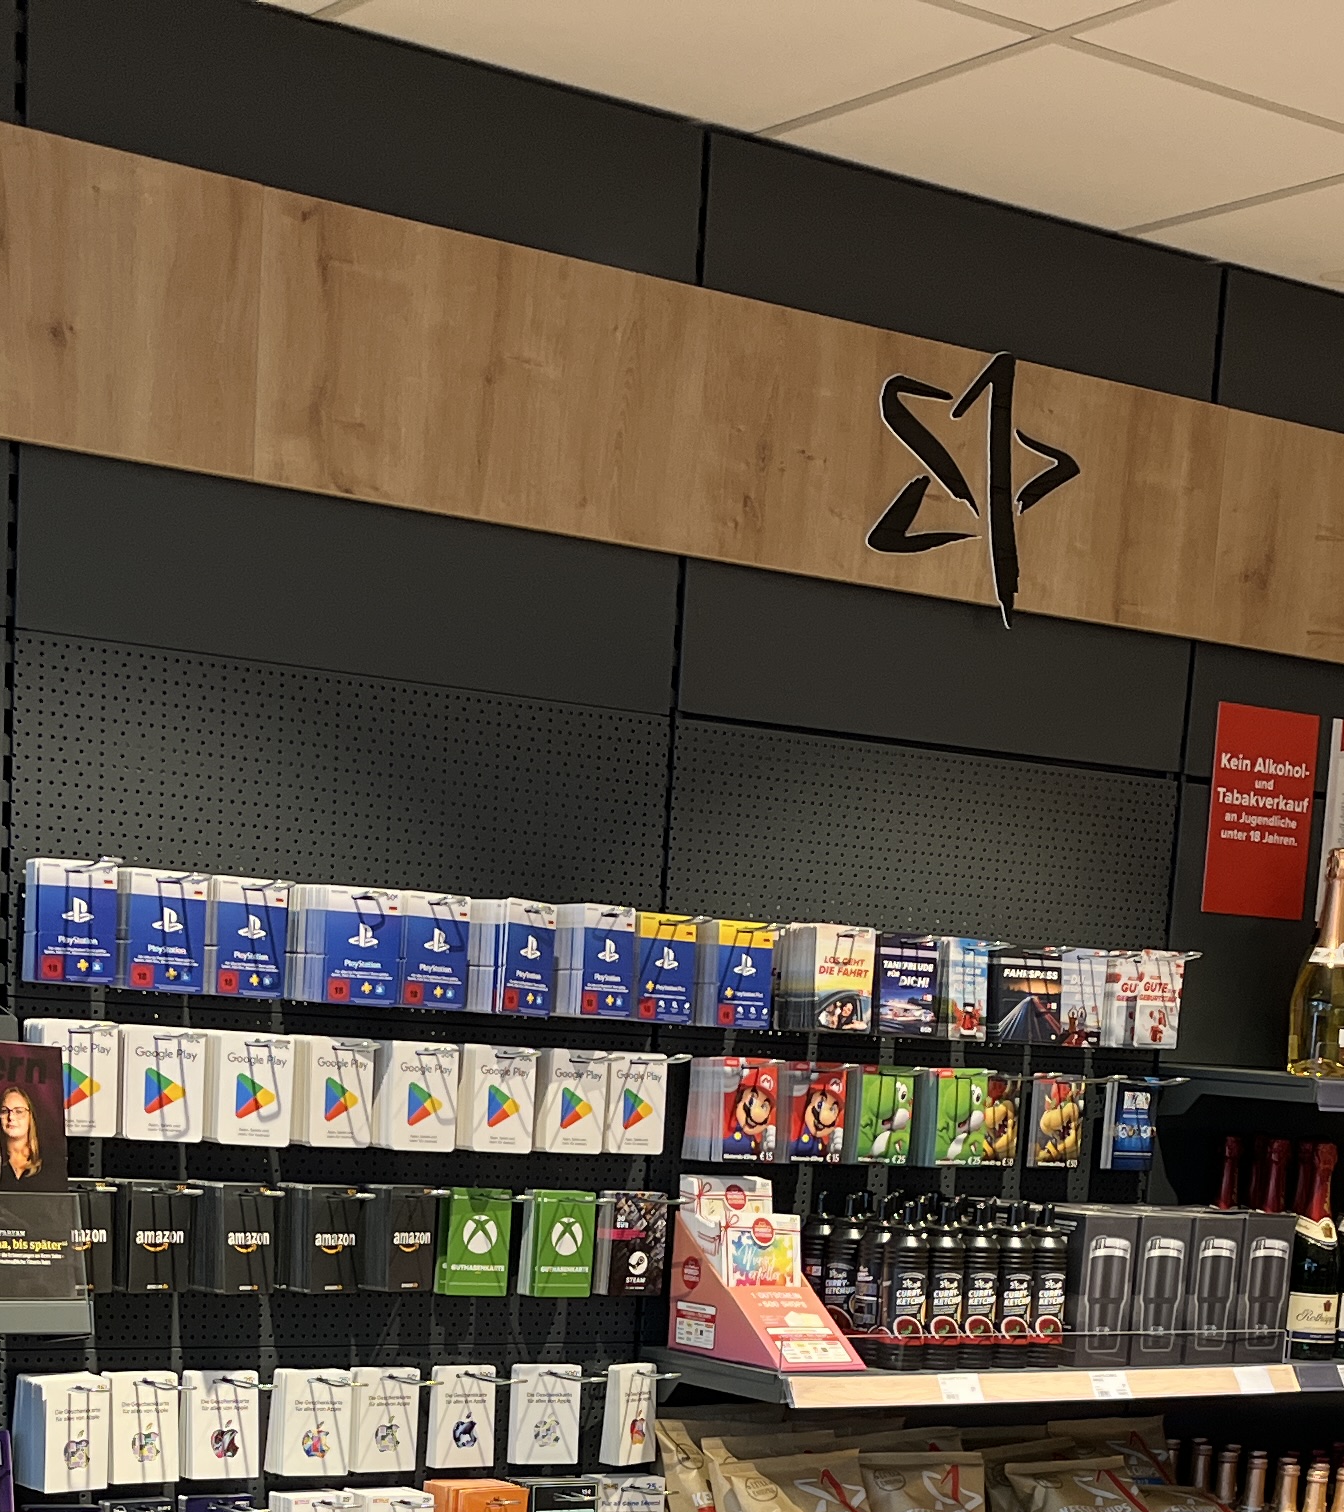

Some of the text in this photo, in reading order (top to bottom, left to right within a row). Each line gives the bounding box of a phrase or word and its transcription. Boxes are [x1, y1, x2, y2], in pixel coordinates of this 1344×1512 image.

[1221, 753, 1310, 778] Kein Alkohol-
[1255, 779, 1274, 790] und
[1217, 787, 1309, 813] Tabakverkauf
[1225, 812, 1297, 829] an Jugendliche
[1221, 828, 1297, 846] unter 18 Jahren.
[58, 935, 98, 946] PlayStation
[819, 965, 869, 978] DIE FAHRT
[899, 975, 930, 988] DICH!
[135, 1046, 198, 1062] Google Play
[135, 1230, 184, 1244] amazon
[13, 1240, 28, 1252] bis
